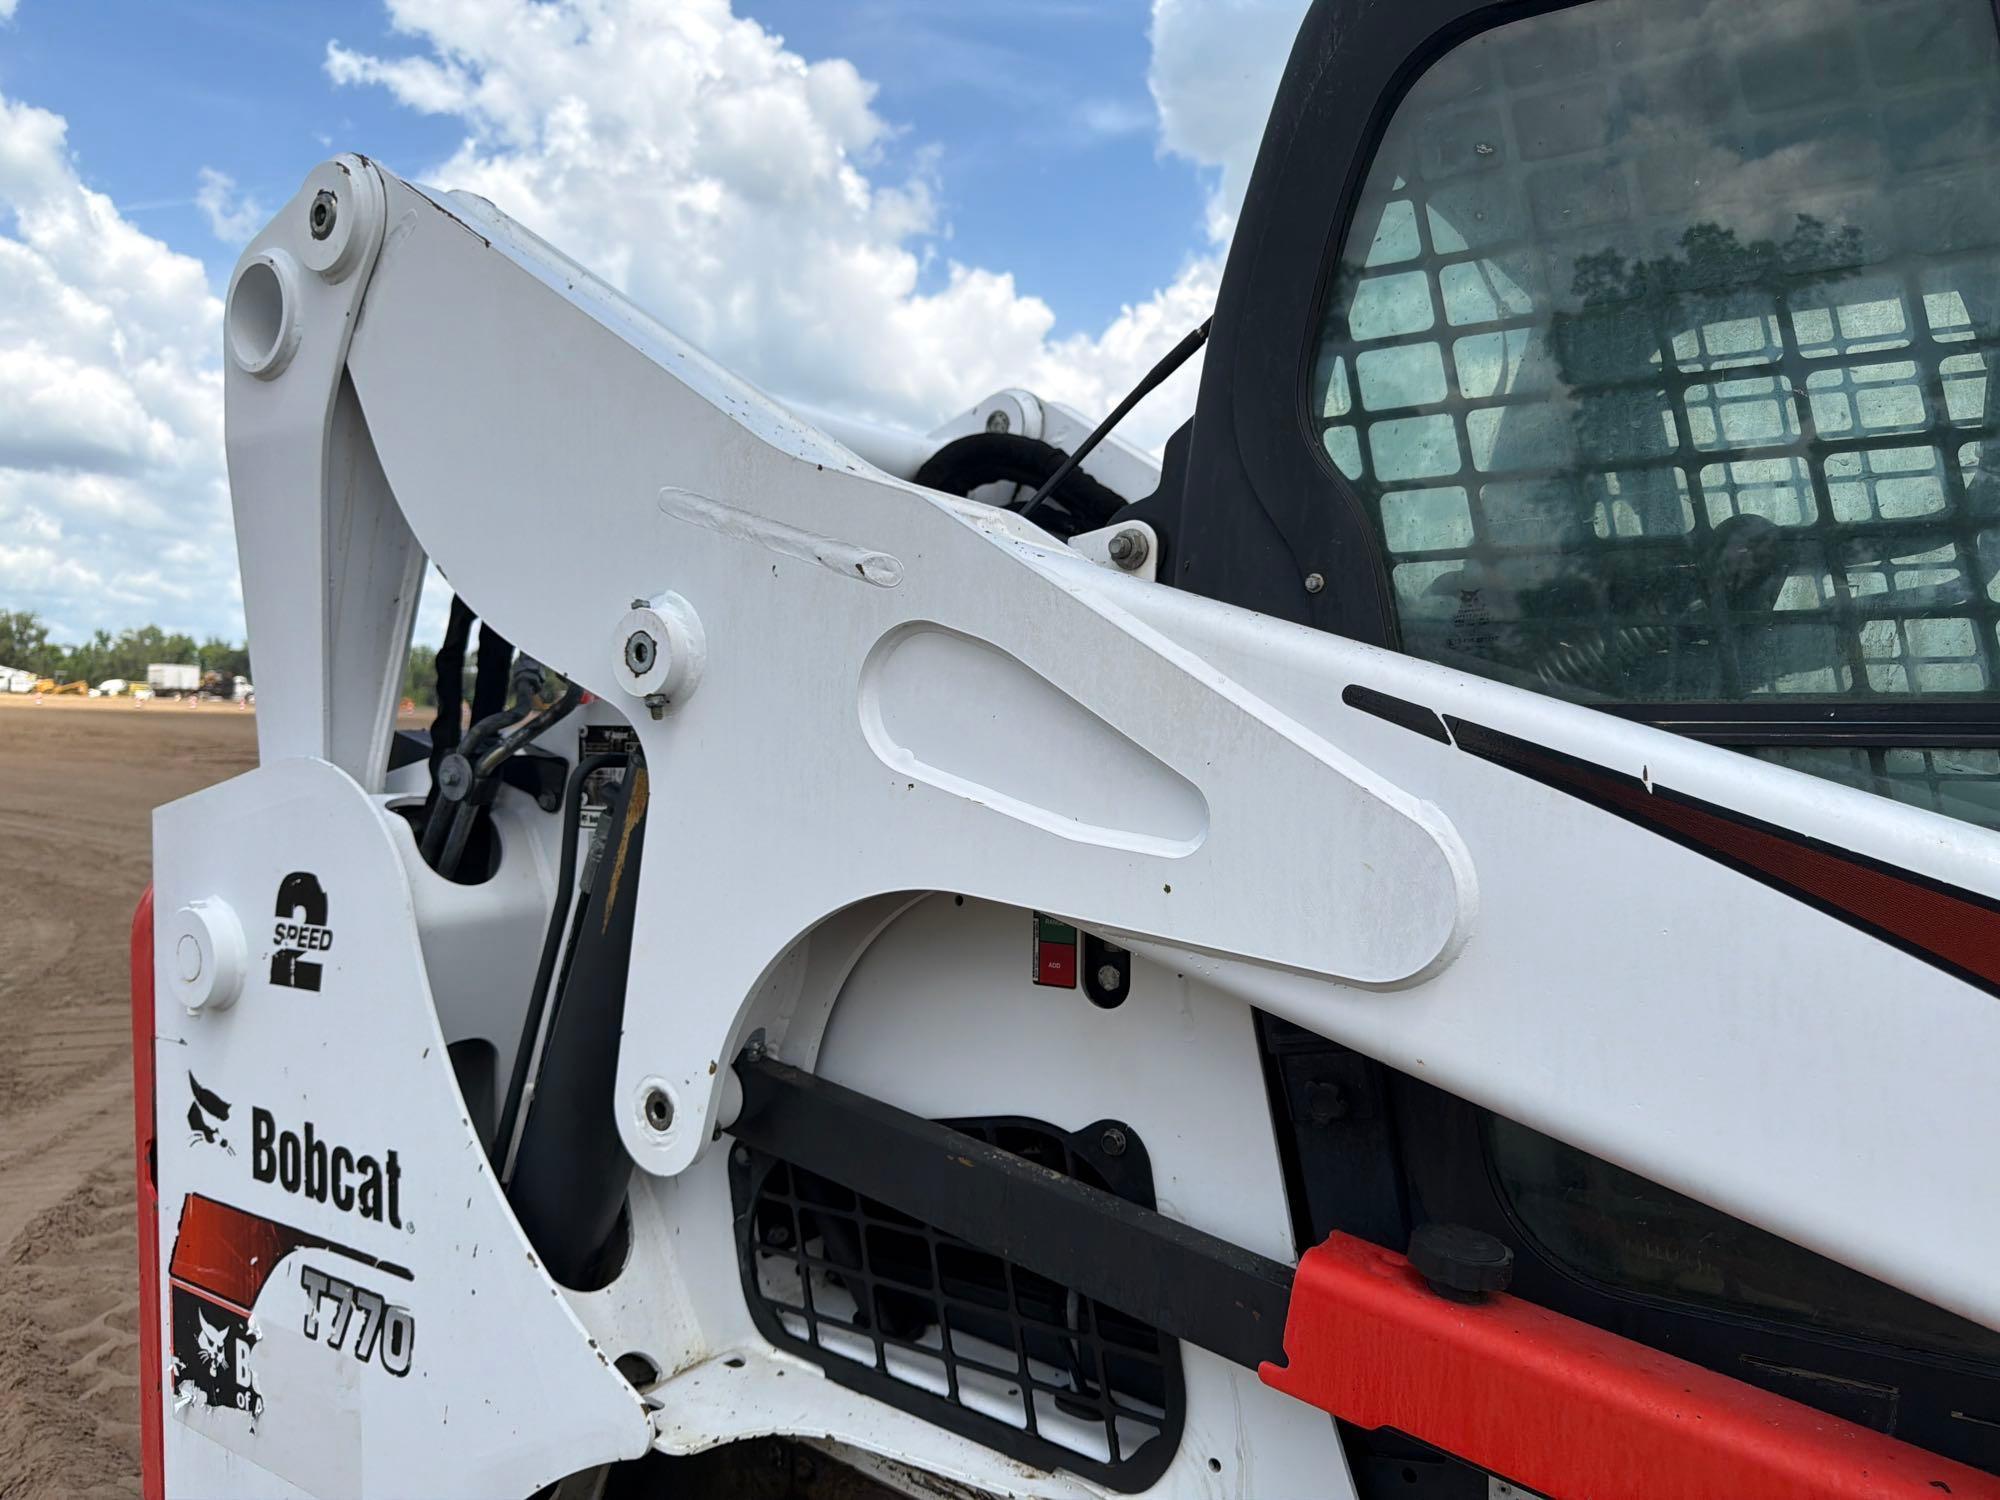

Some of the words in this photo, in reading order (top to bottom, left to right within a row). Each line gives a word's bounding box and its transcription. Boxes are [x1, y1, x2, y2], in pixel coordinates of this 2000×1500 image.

[273, 922, 334, 952] SPEED
[252, 1105, 402, 1230] Bobcat
[301, 1264, 415, 1378] T770
[236, 1391, 251, 1411] of
